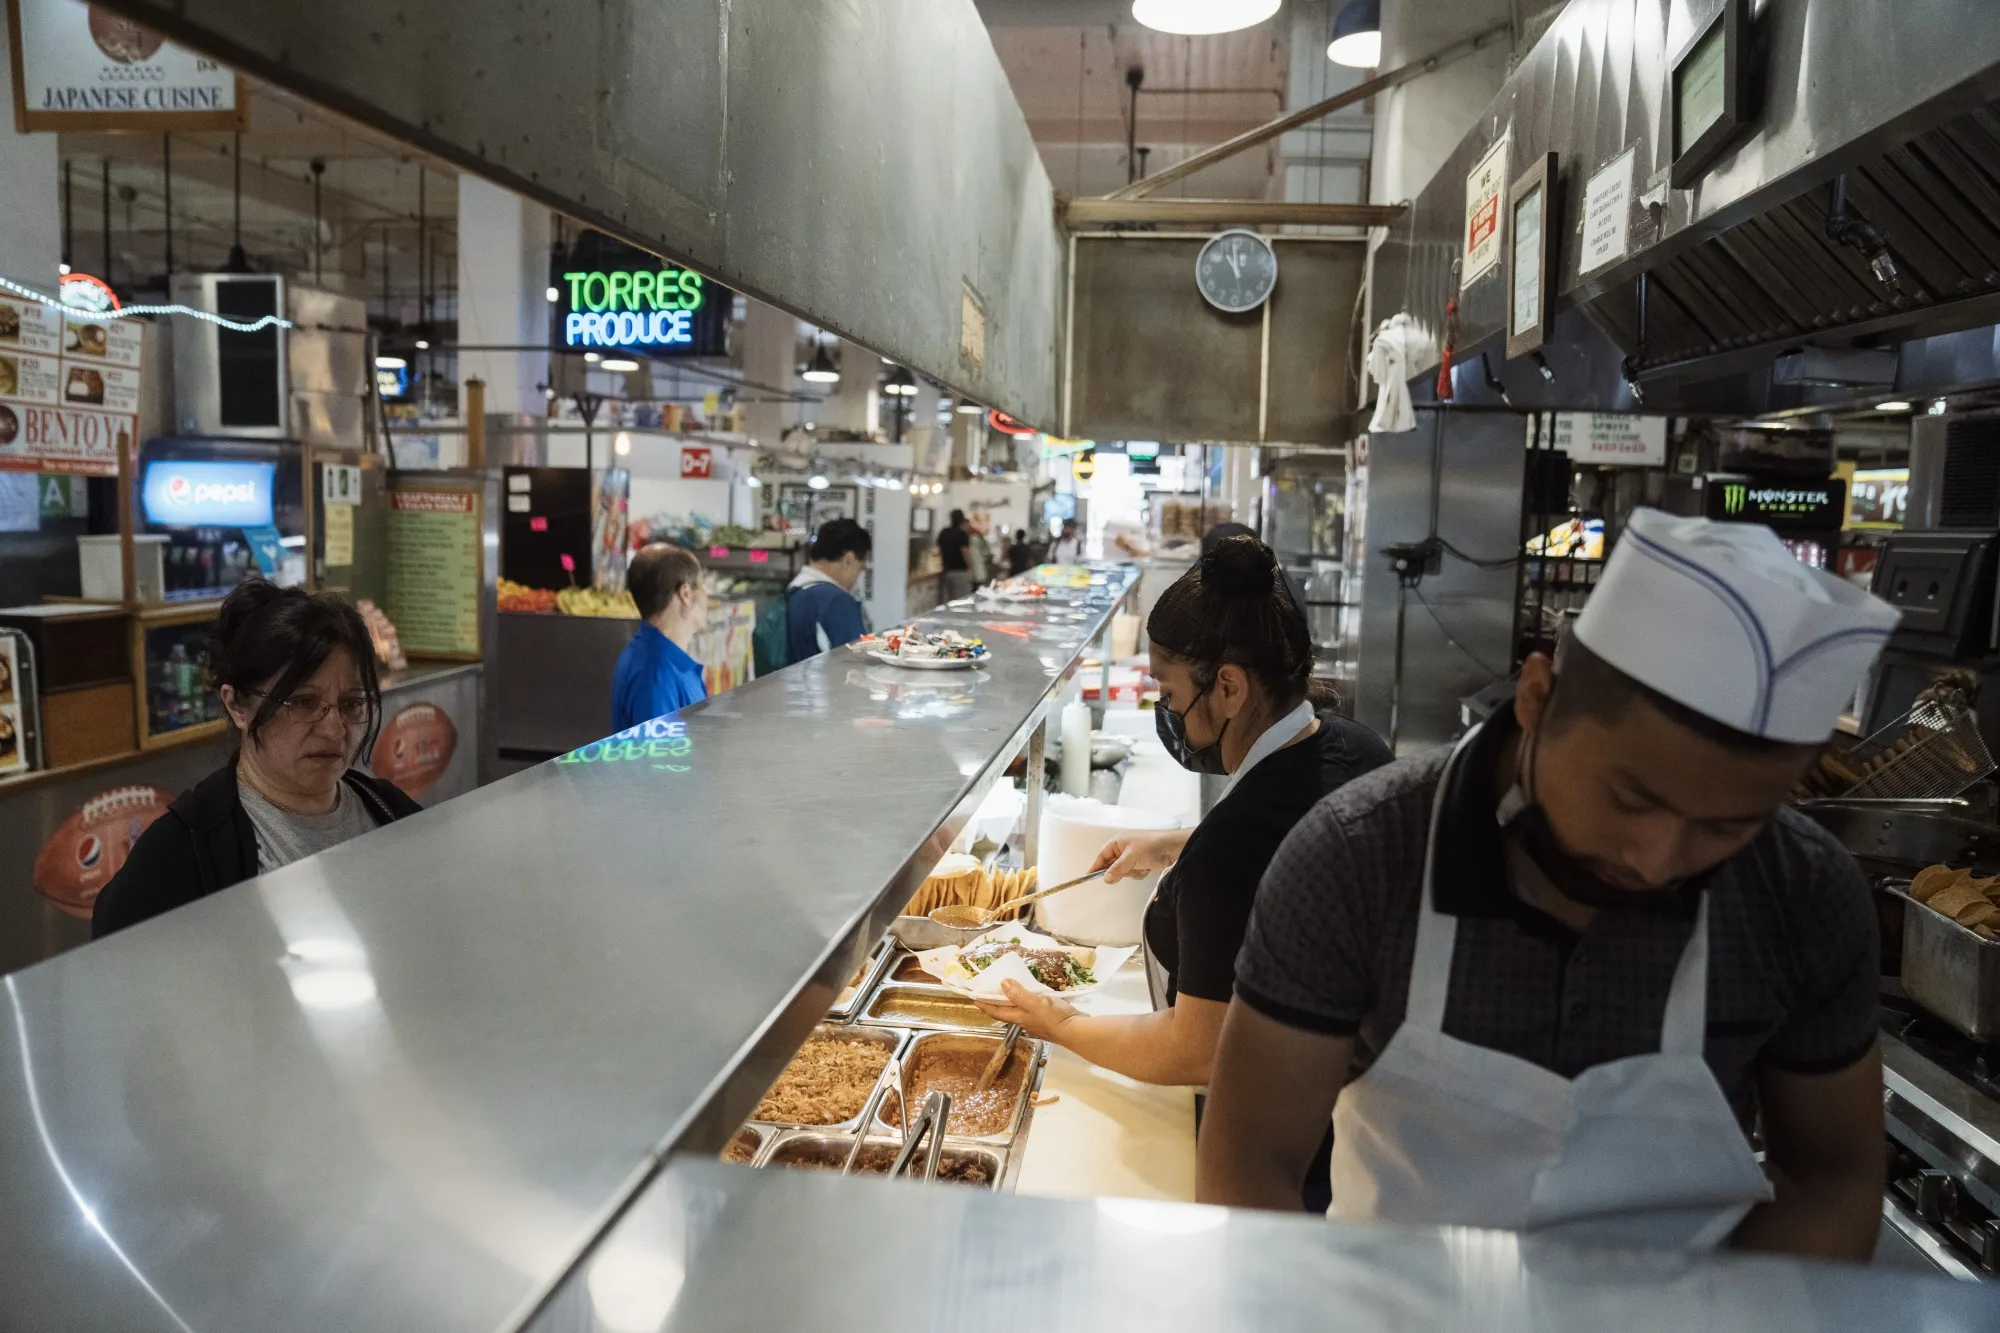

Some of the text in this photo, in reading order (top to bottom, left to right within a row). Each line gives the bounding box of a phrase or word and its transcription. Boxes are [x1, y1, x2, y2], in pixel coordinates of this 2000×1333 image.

[43, 87, 222, 109] JAPANESE CUISINE
[1481, 168, 1491, 188] WE
[563, 270, 703, 313] TORRES
[566, 310, 692, 346] PRODUCE
[25, 408, 98, 450] BENTO
[194, 480, 255, 505] pepsi
[1748, 488, 1829, 504] MONSTER
[1759, 503, 1817, 512] ENERGY
